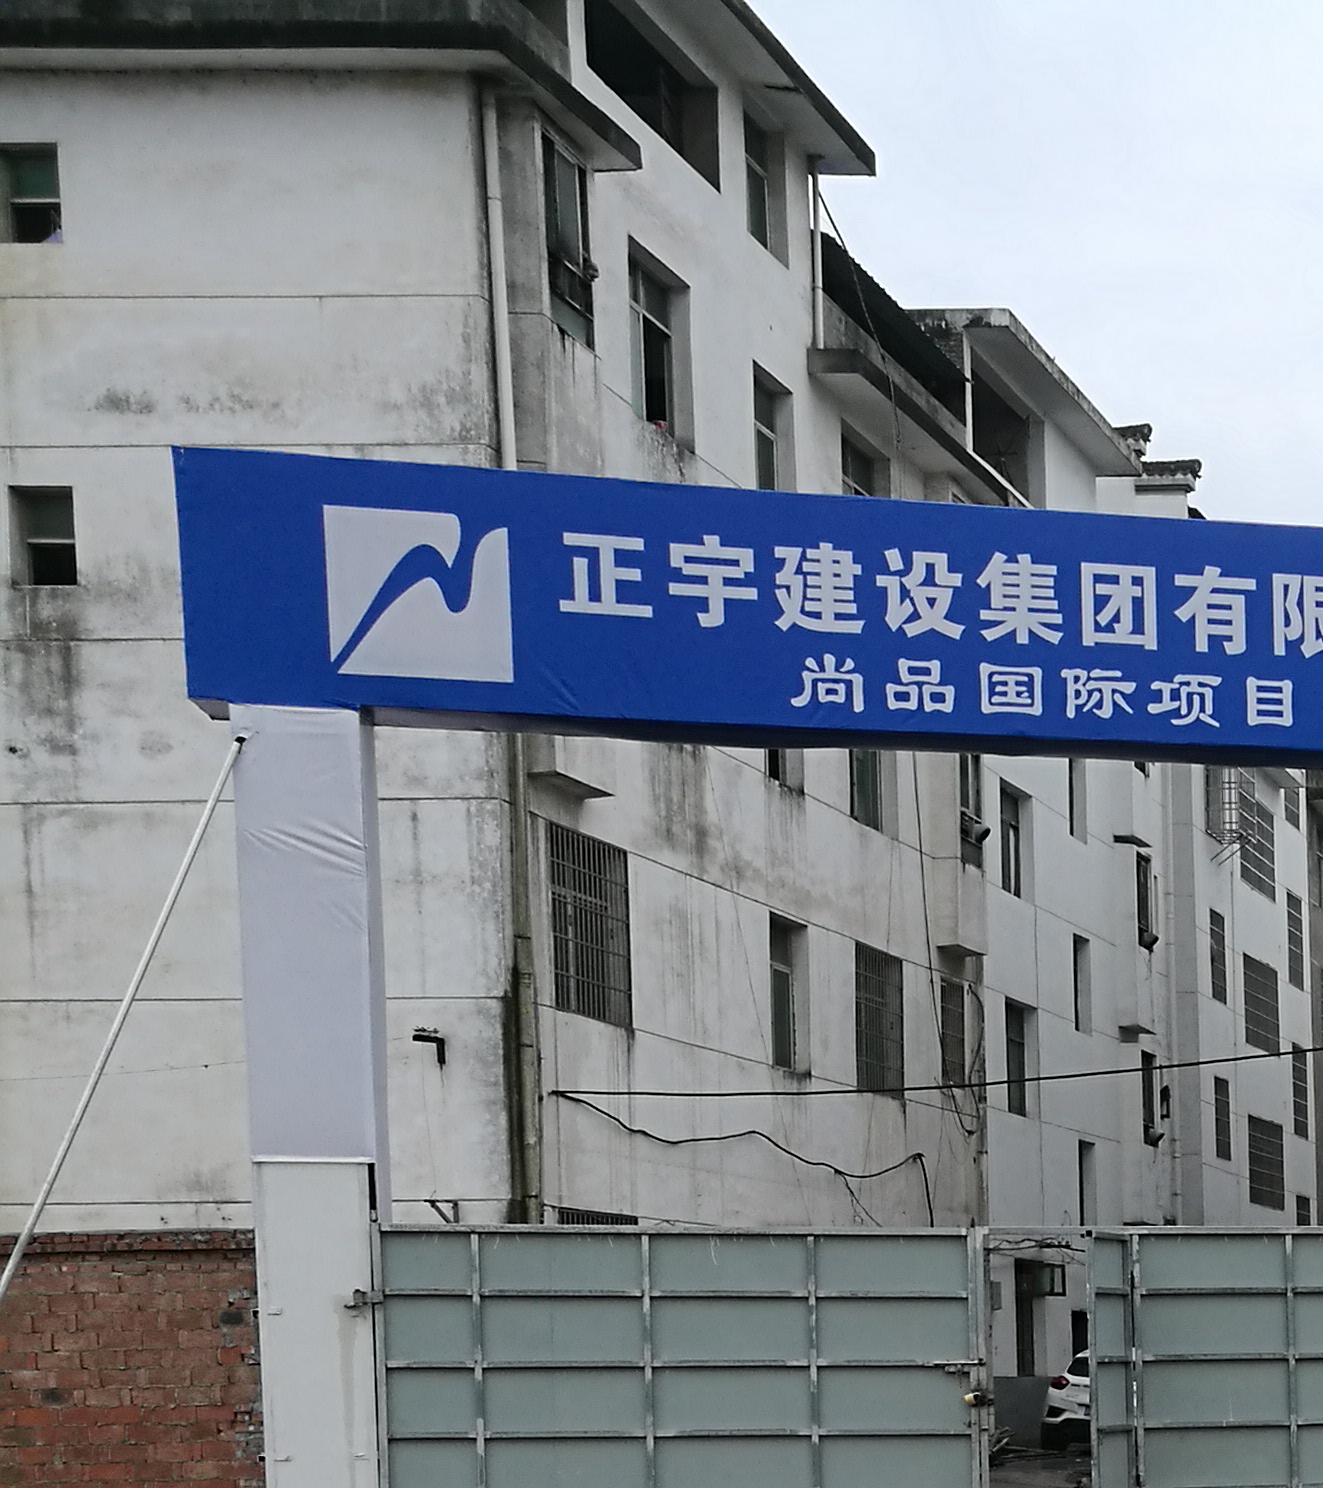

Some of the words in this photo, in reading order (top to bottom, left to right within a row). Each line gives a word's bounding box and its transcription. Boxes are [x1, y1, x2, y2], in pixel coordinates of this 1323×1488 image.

[789, 655, 1295, 729] 尚品国际项目
